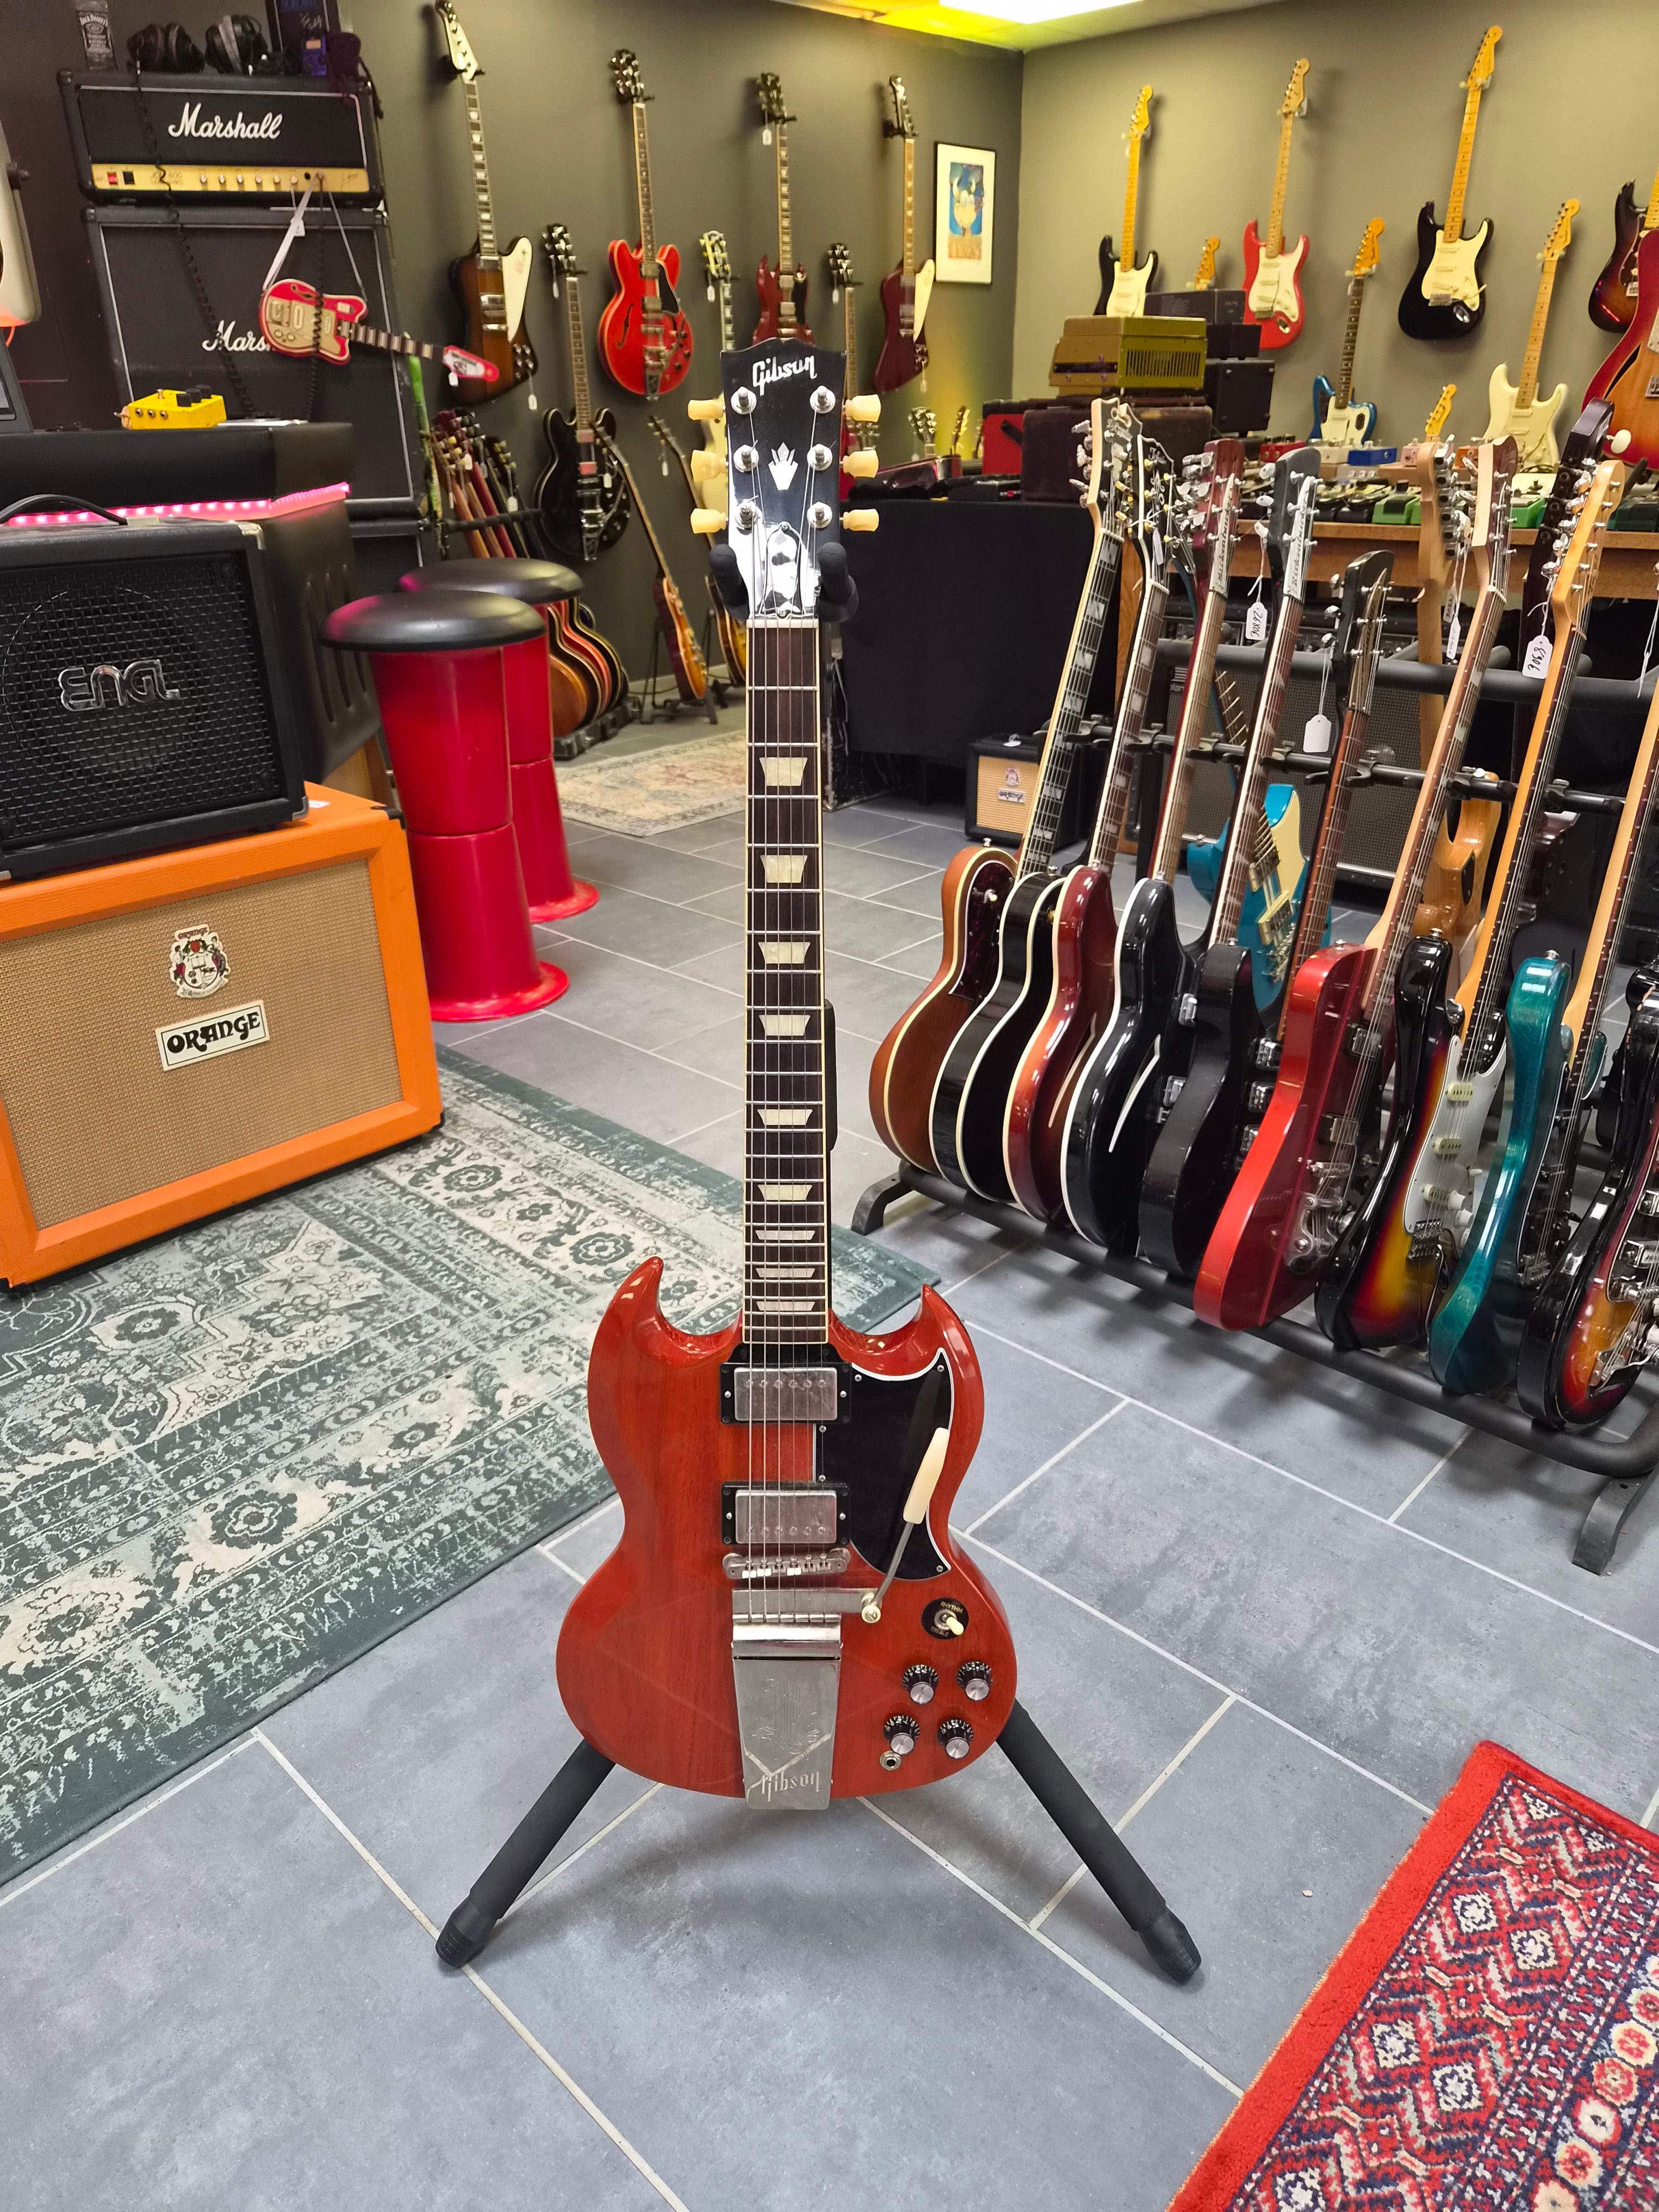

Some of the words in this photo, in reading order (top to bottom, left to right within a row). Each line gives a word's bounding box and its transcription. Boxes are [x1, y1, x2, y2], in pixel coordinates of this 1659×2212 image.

[168, 102, 283, 139] Marshall
[202, 320, 270, 352] Mars
[753, 355, 817, 396] Gibson
[58, 659, 180, 712] ENGL
[167, 1011, 260, 1053] ORANGE
[940, 1601, 963, 1614] RHYTHM
[930, 1626, 950, 1637] TREBLE
